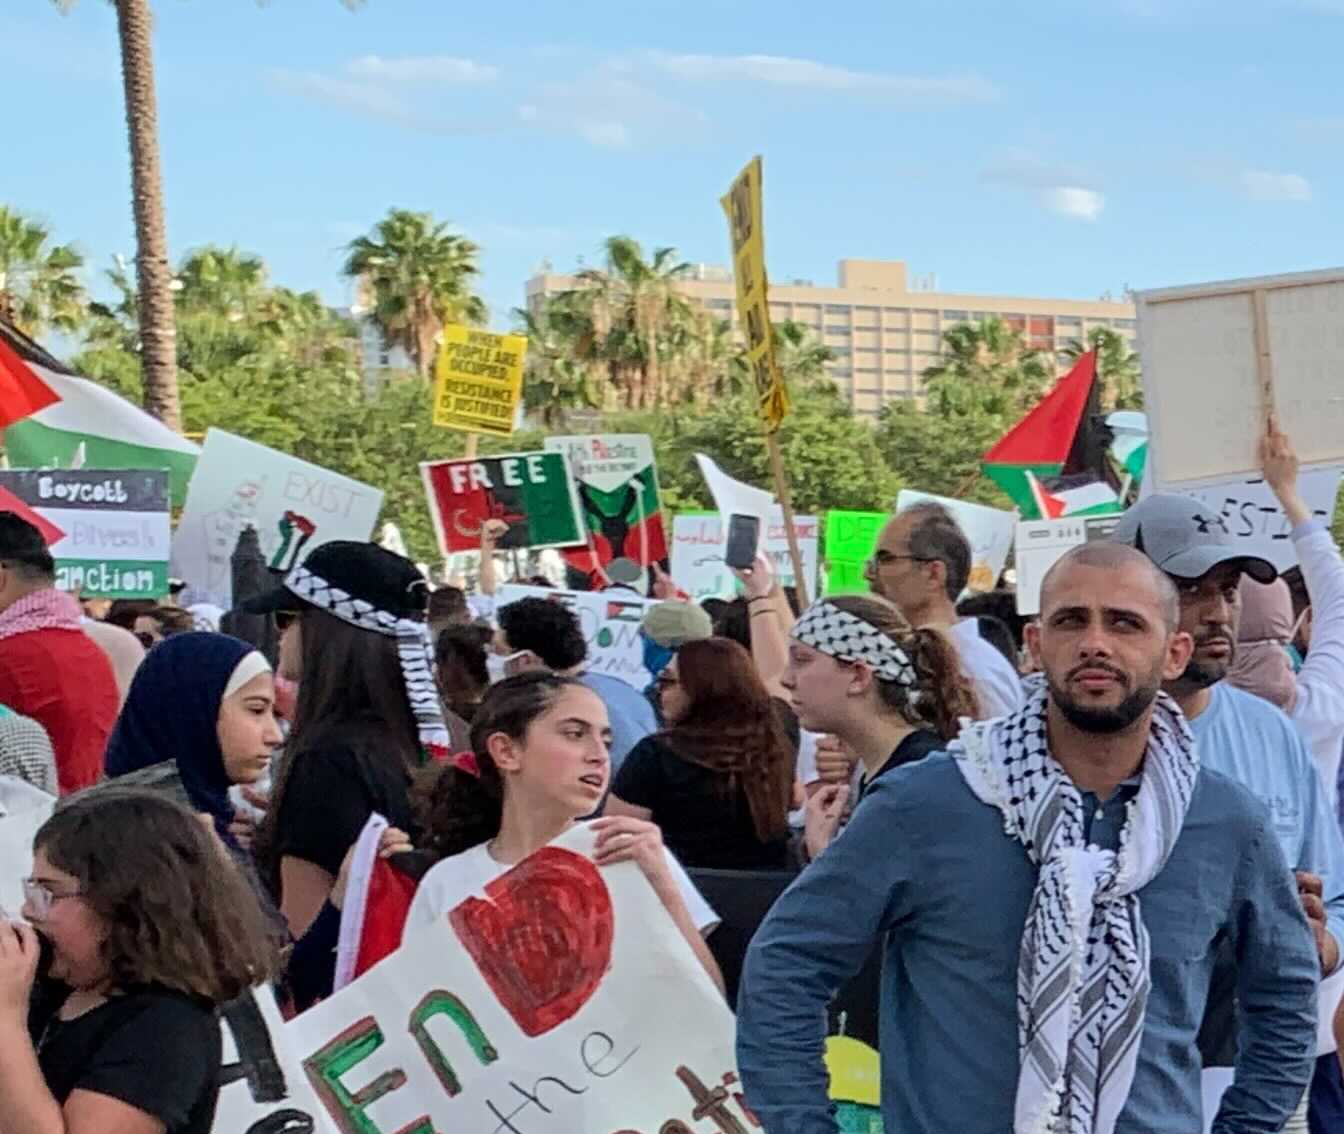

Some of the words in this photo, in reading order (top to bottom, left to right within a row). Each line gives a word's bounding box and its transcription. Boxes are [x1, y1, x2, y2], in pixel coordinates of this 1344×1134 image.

[38, 477, 128, 503] Boycott
[450, 455, 547, 495] FREE
[283, 470, 369, 519] EXIST
[55, 563, 153, 592] anction
